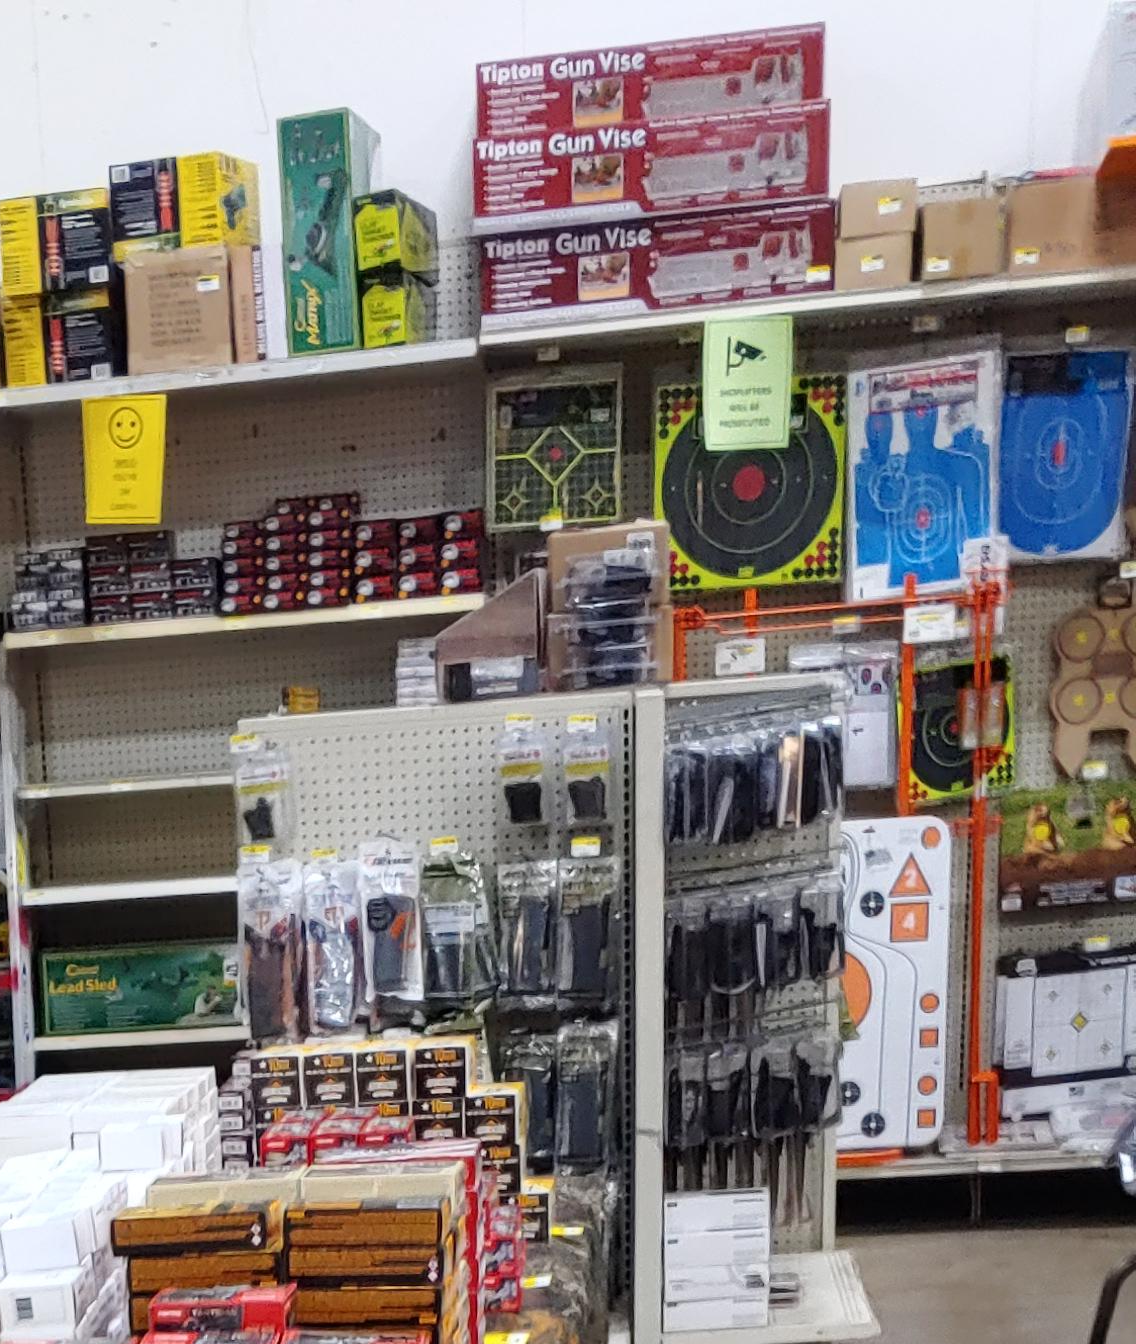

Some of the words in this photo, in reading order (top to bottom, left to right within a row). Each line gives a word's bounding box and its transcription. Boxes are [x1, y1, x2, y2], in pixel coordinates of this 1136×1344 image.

[480, 62, 545, 86] Tipton
[550, 56, 596, 80] Gun
[598, 51, 647, 74] Vise
[476, 138, 544, 161] Tipton
[548, 132, 596, 157] Gun
[598, 127, 647, 150] Vise
[484, 238, 550, 260] Tipton
[555, 231, 602, 255] Gun
[604, 226, 653, 250] Vise
[49, 979, 84, 995] Lead
